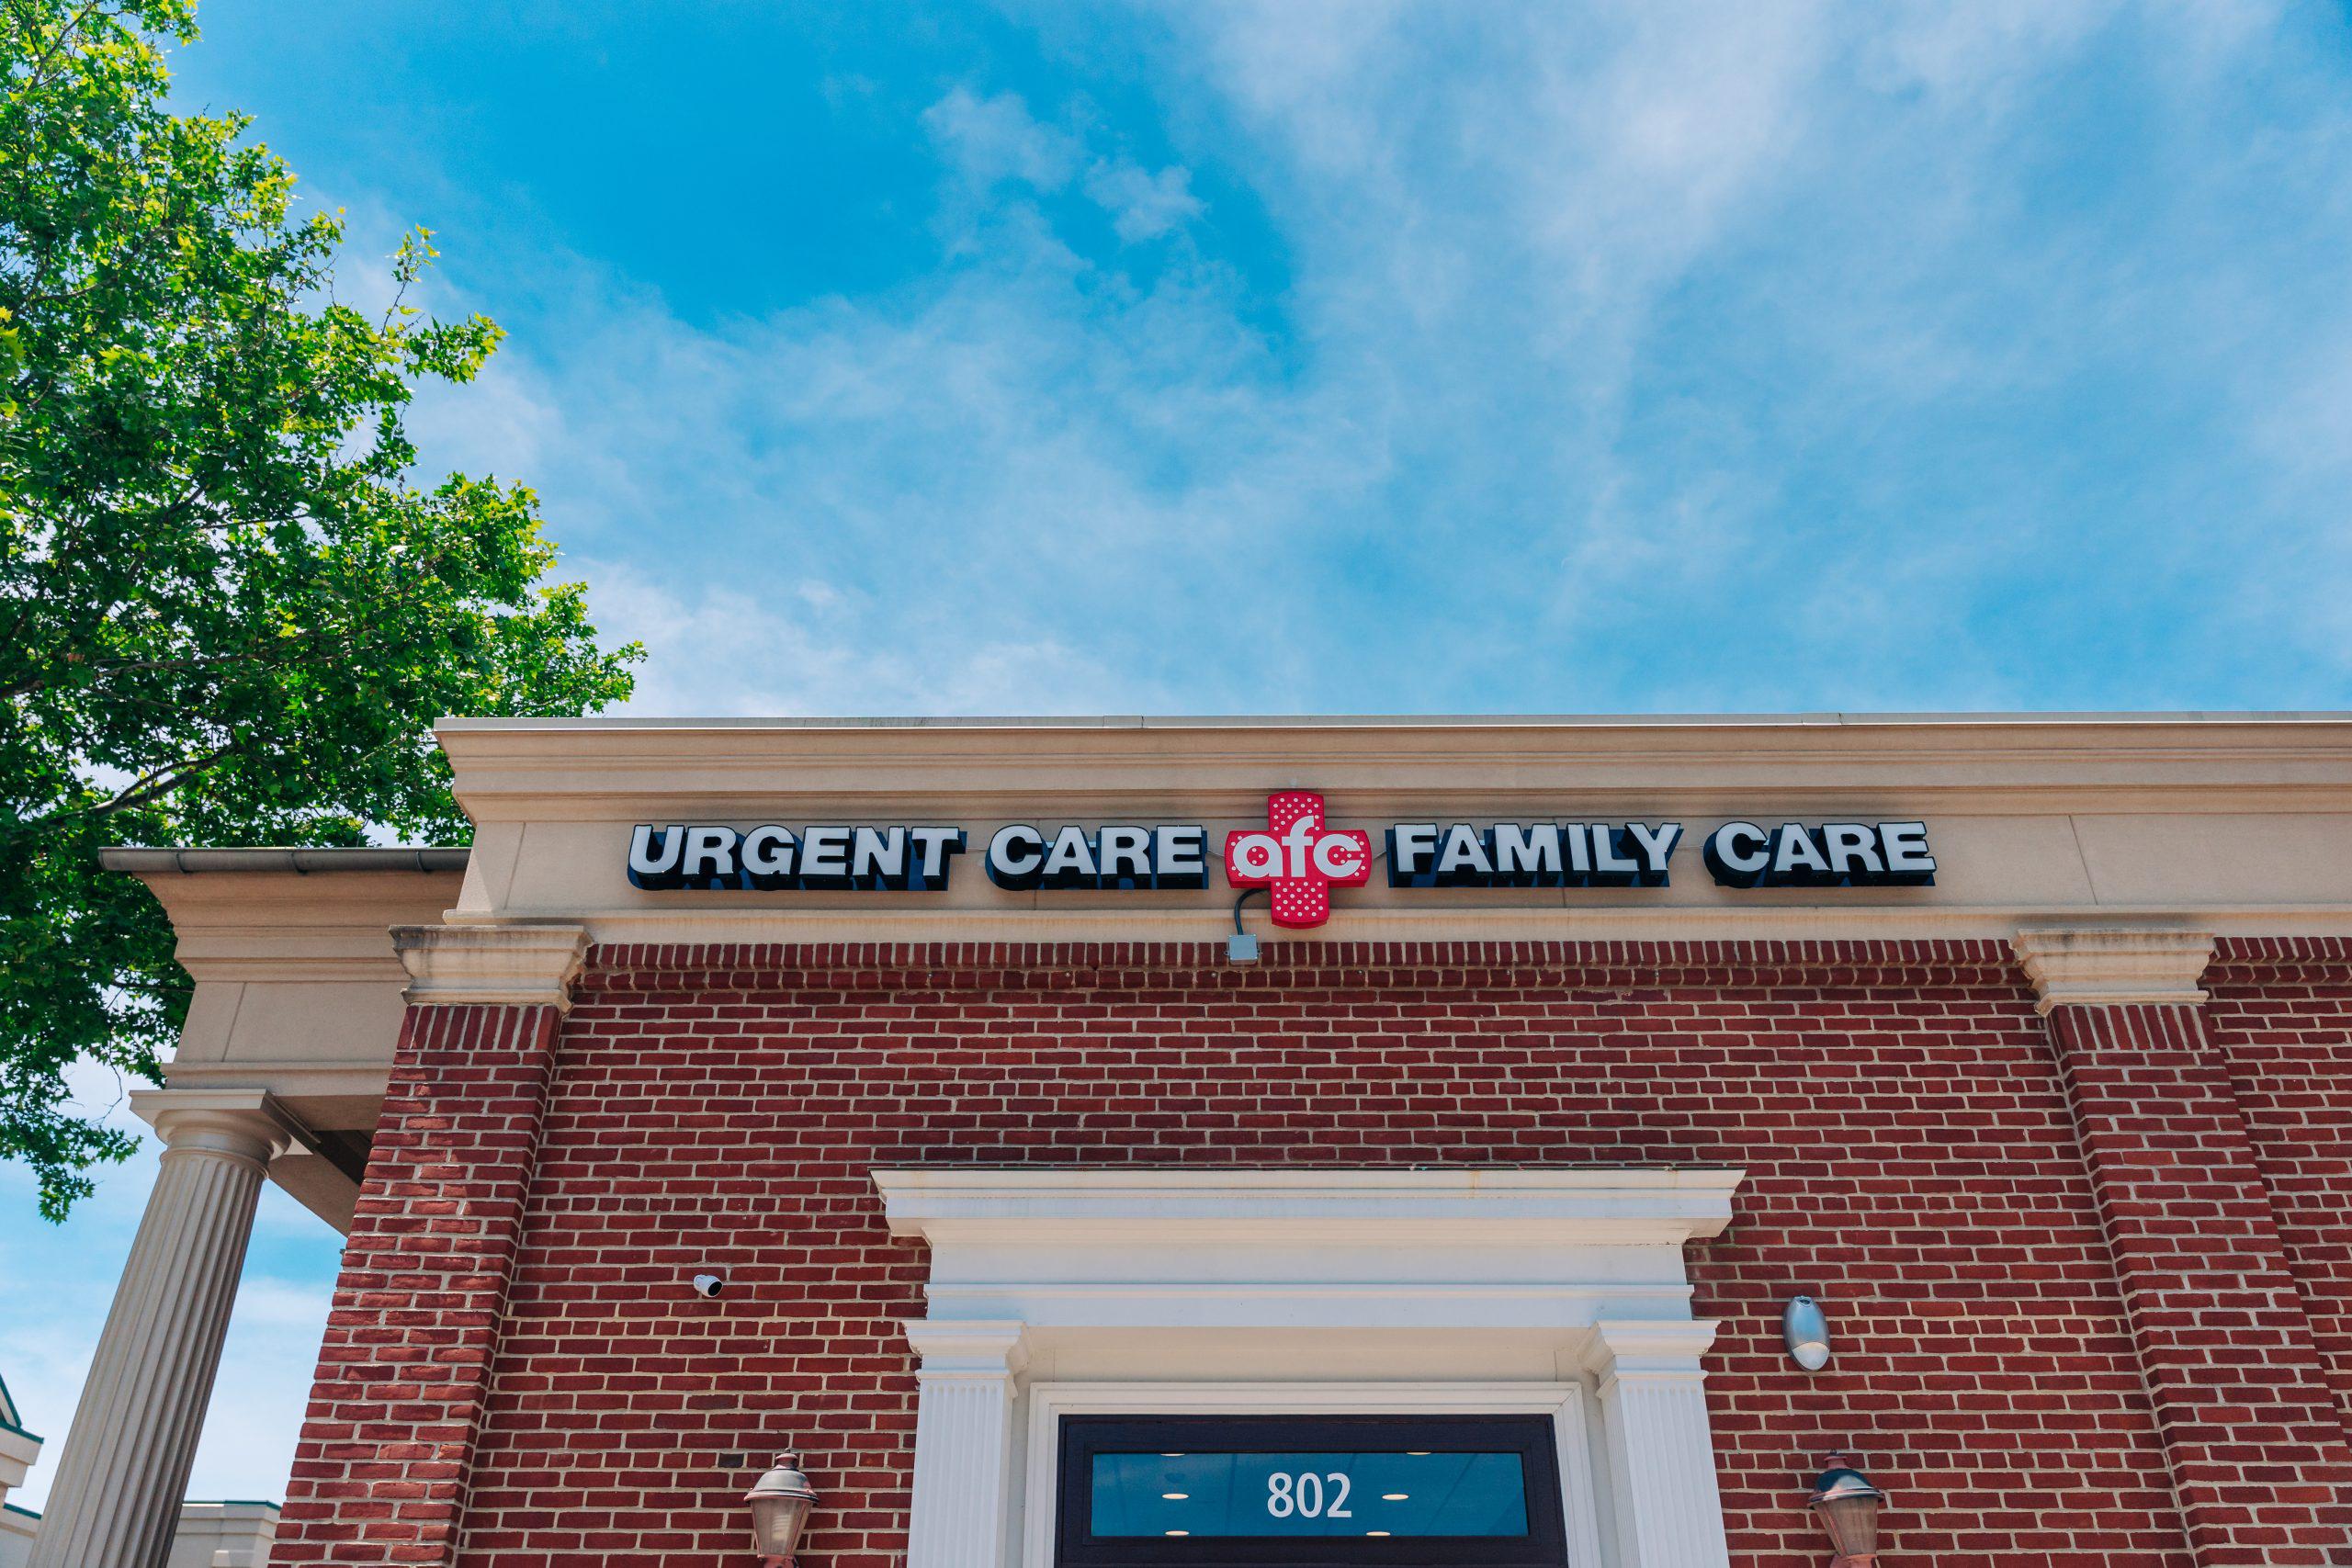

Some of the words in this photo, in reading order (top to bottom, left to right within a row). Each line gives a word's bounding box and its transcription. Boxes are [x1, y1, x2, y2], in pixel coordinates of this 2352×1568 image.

[628, 824, 960, 878] URGENT
[989, 824, 1204, 877] CARE
[1232, 815, 1363, 879] afc
[1393, 822, 1681, 874] FAMILY
[1714, 820, 1937, 874] CARE
[1266, 1471, 1353, 1519] 802
